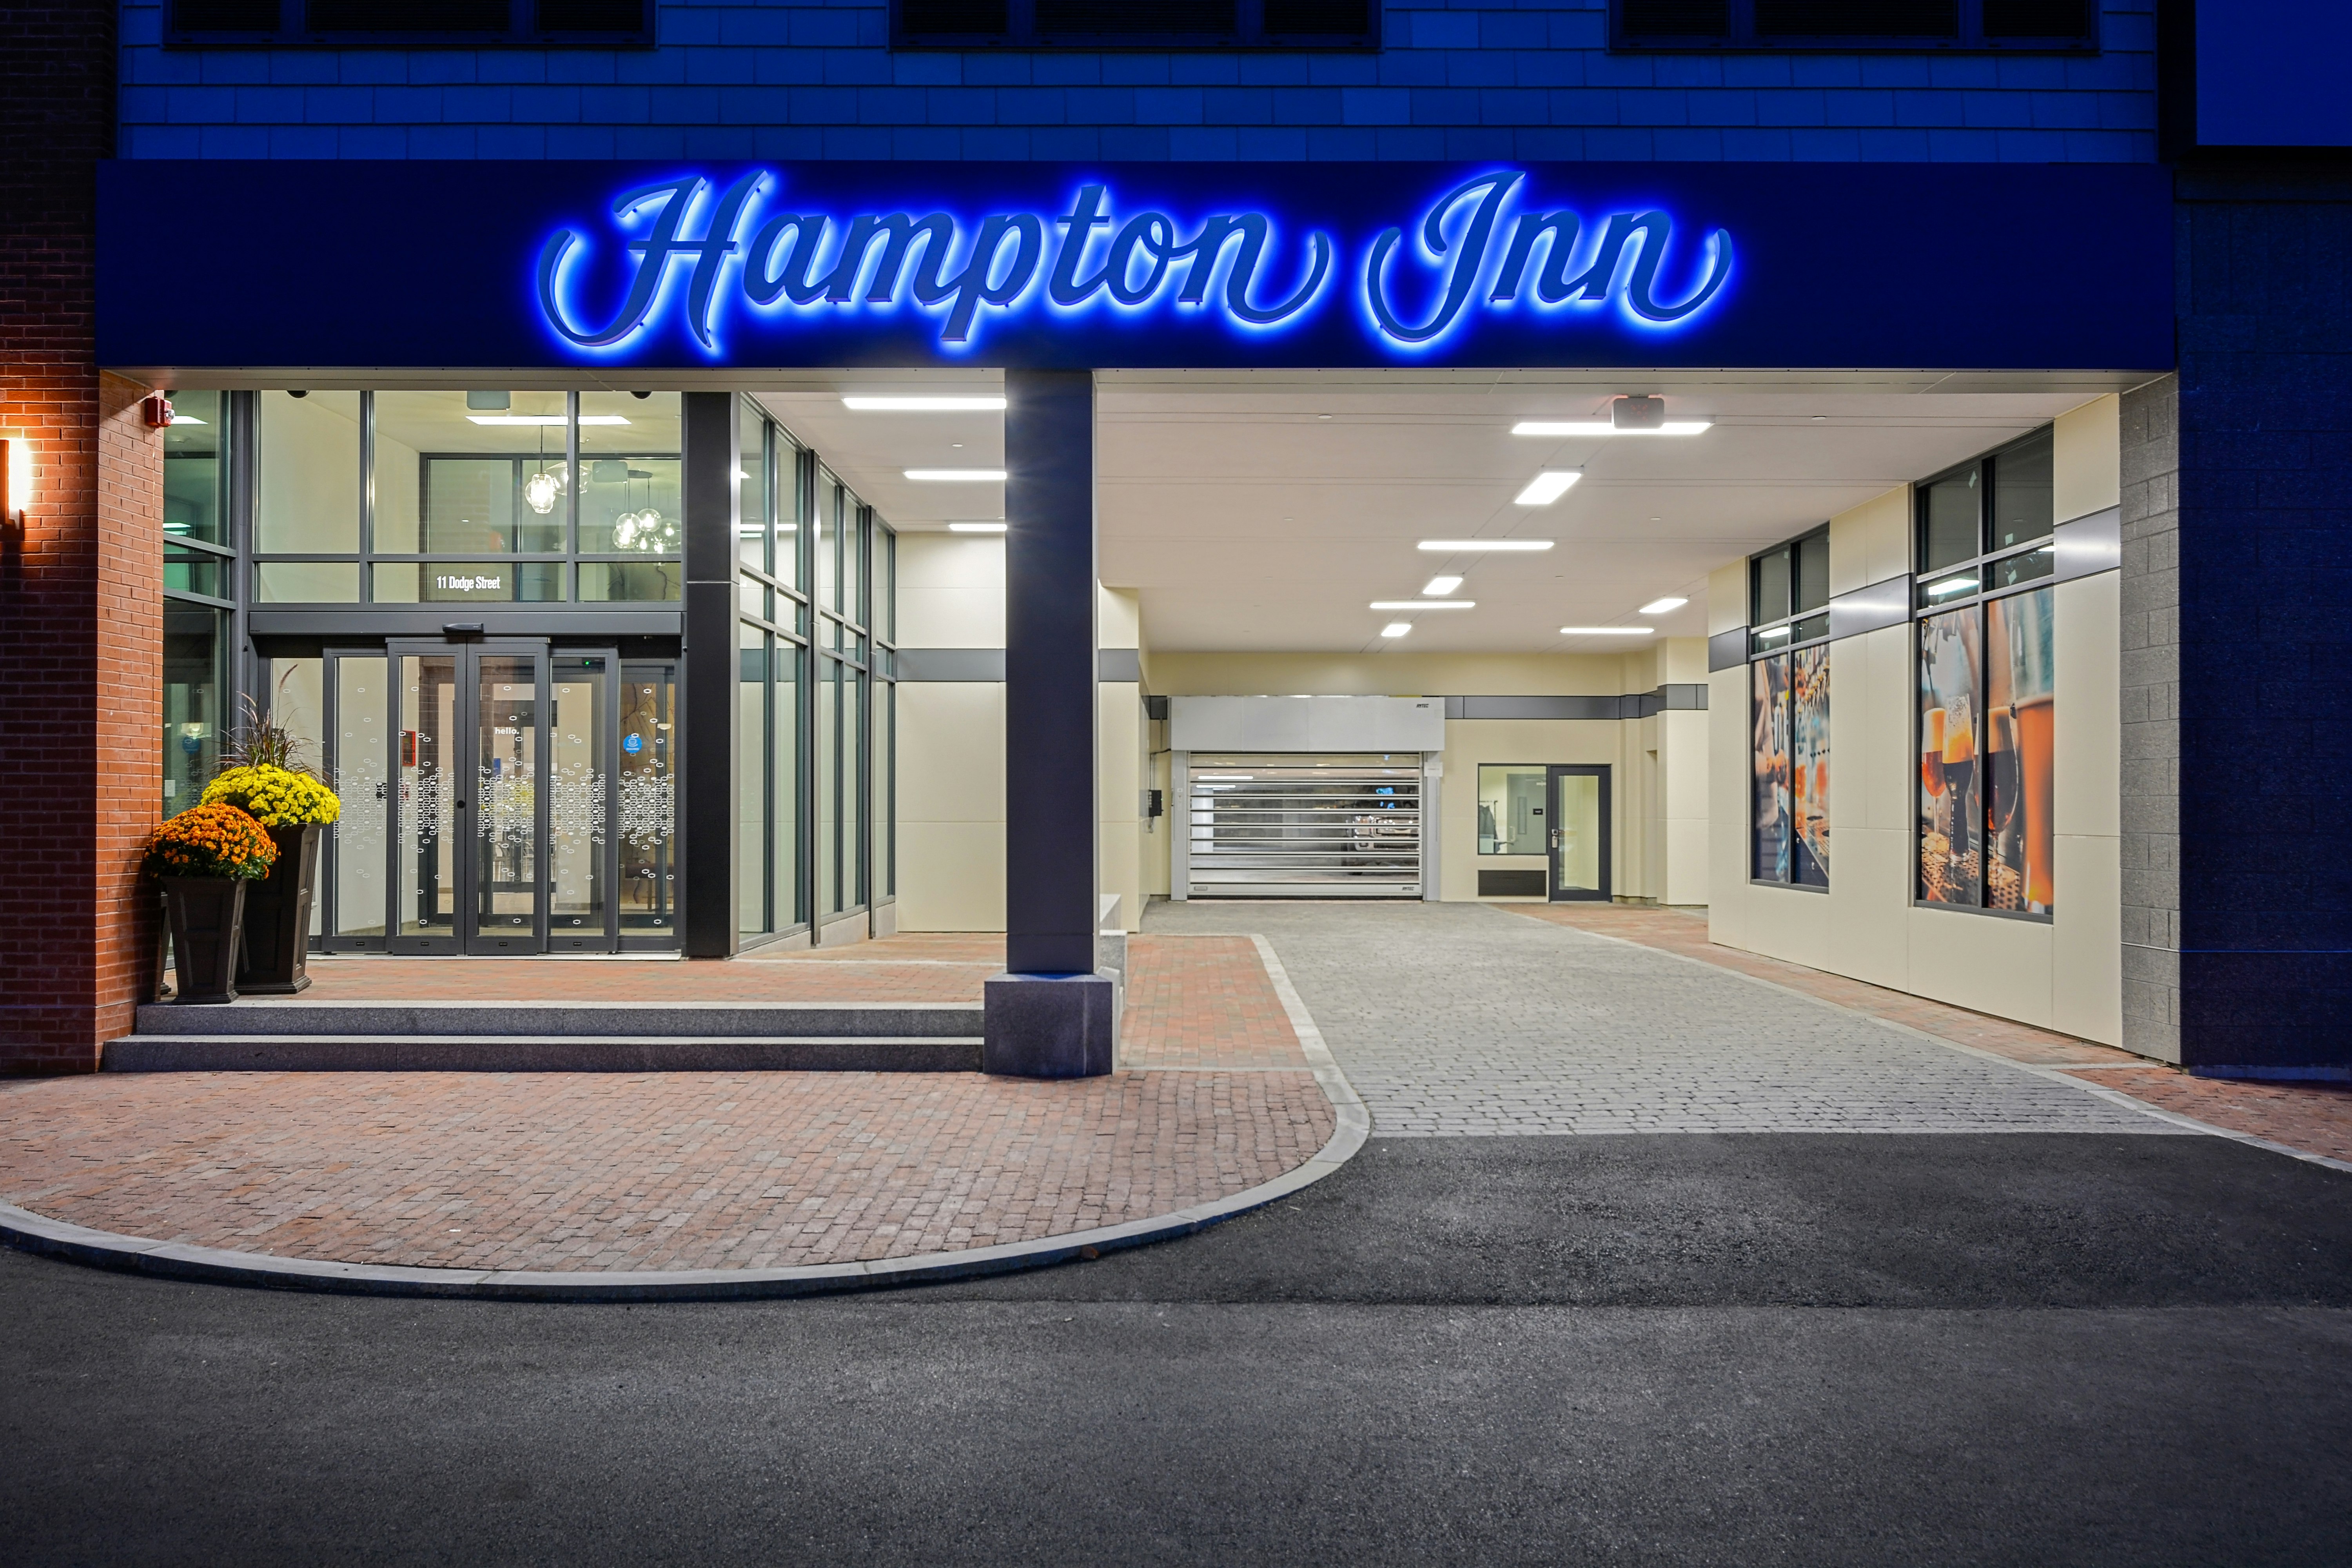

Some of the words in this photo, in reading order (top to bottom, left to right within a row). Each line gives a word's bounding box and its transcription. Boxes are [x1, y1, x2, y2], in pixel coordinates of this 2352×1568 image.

[538, 170, 1330, 348] Hampton
[1367, 171, 1733, 343] Inn
[437, 576, 446, 589] 11
[449, 576, 474, 592] Dodge
[475, 576, 500, 589] Street
